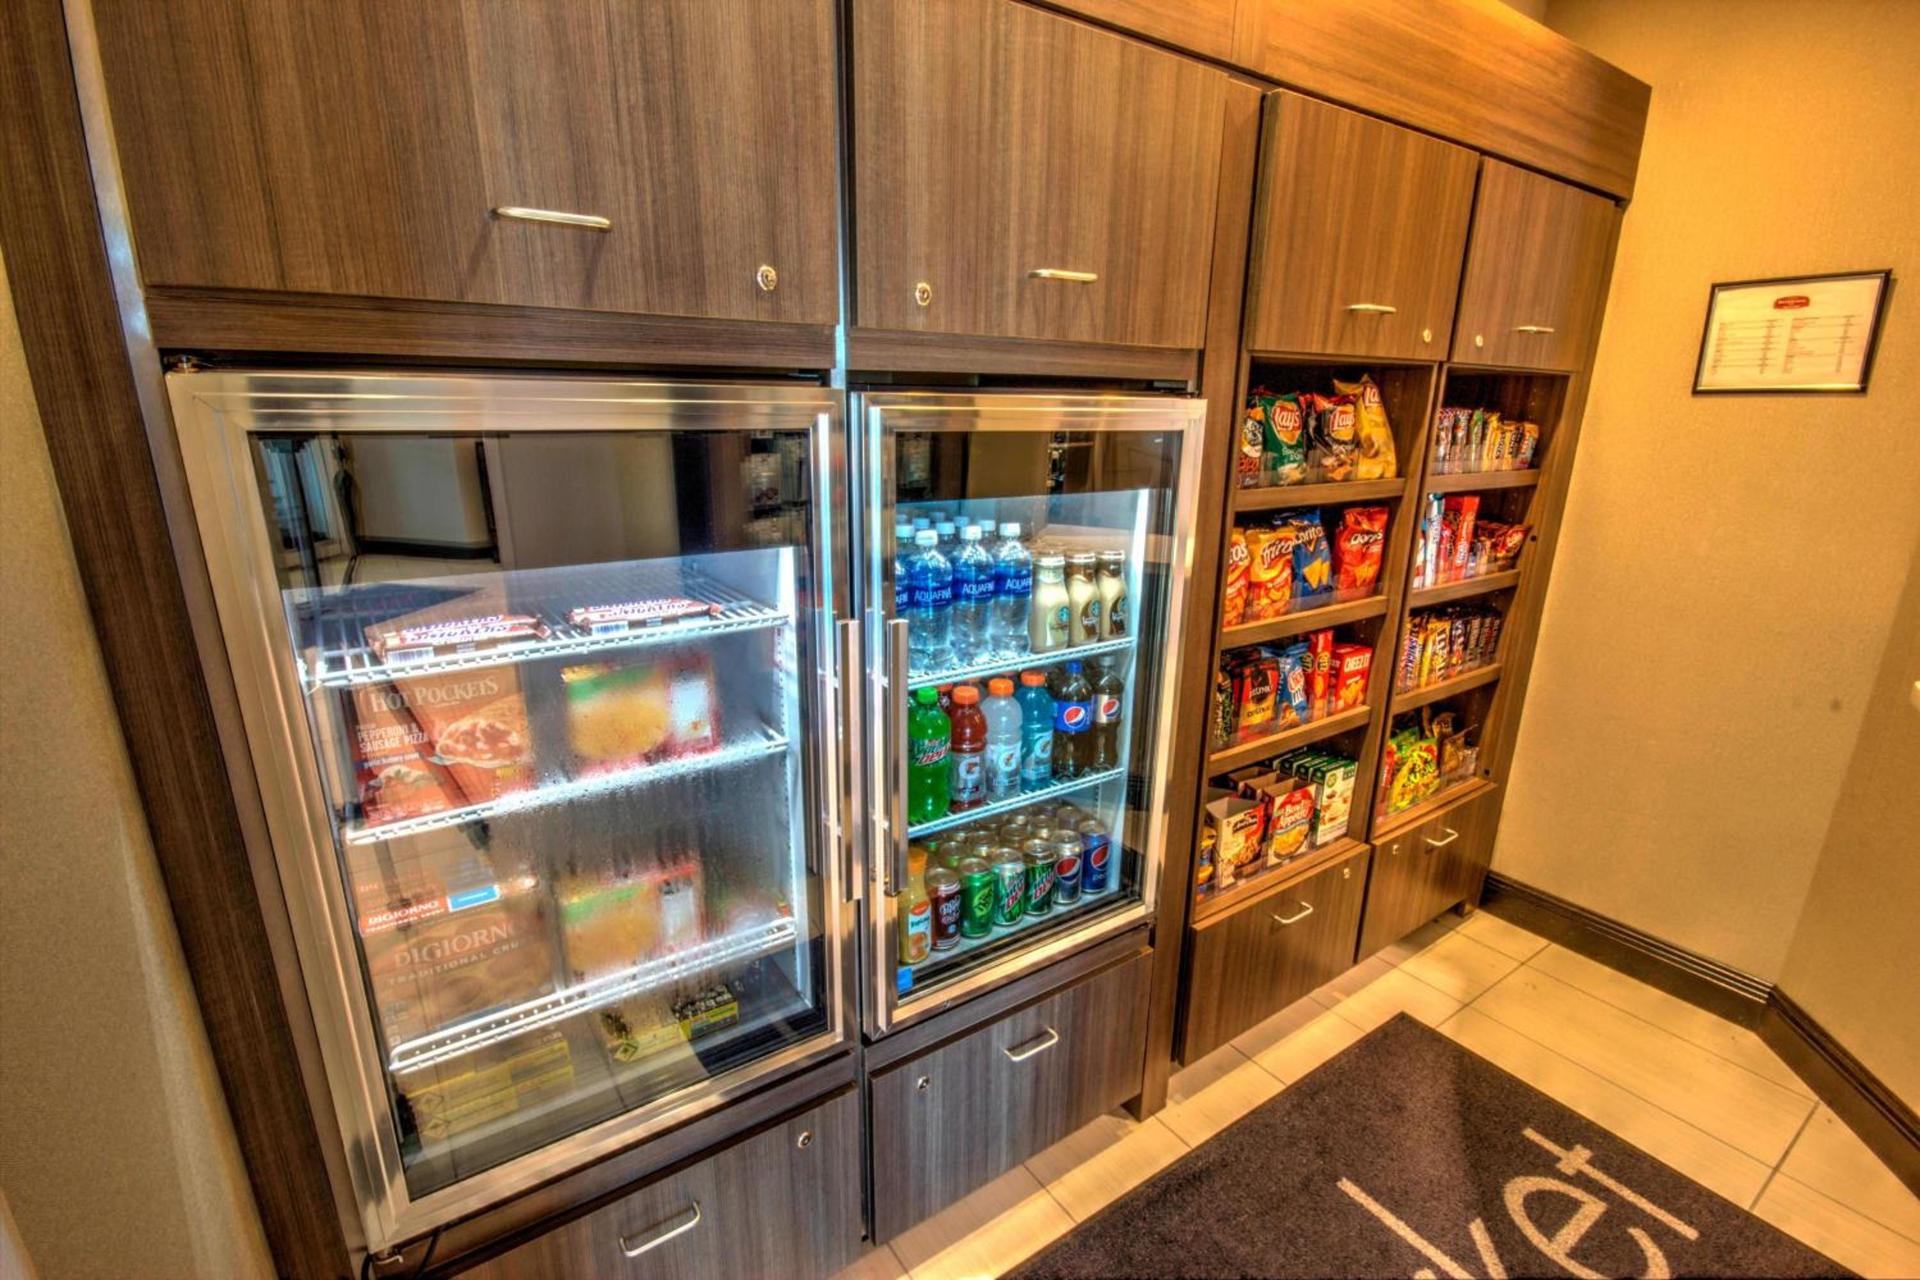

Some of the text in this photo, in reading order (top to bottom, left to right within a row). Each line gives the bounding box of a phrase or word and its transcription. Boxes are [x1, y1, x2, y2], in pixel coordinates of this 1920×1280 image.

[415, 676, 499, 706] POCKETS
[360, 738, 401, 753] SAUSAGE
[367, 900, 439, 925] DIGIORNO
[390, 951, 487, 986] TRADITIONAL
